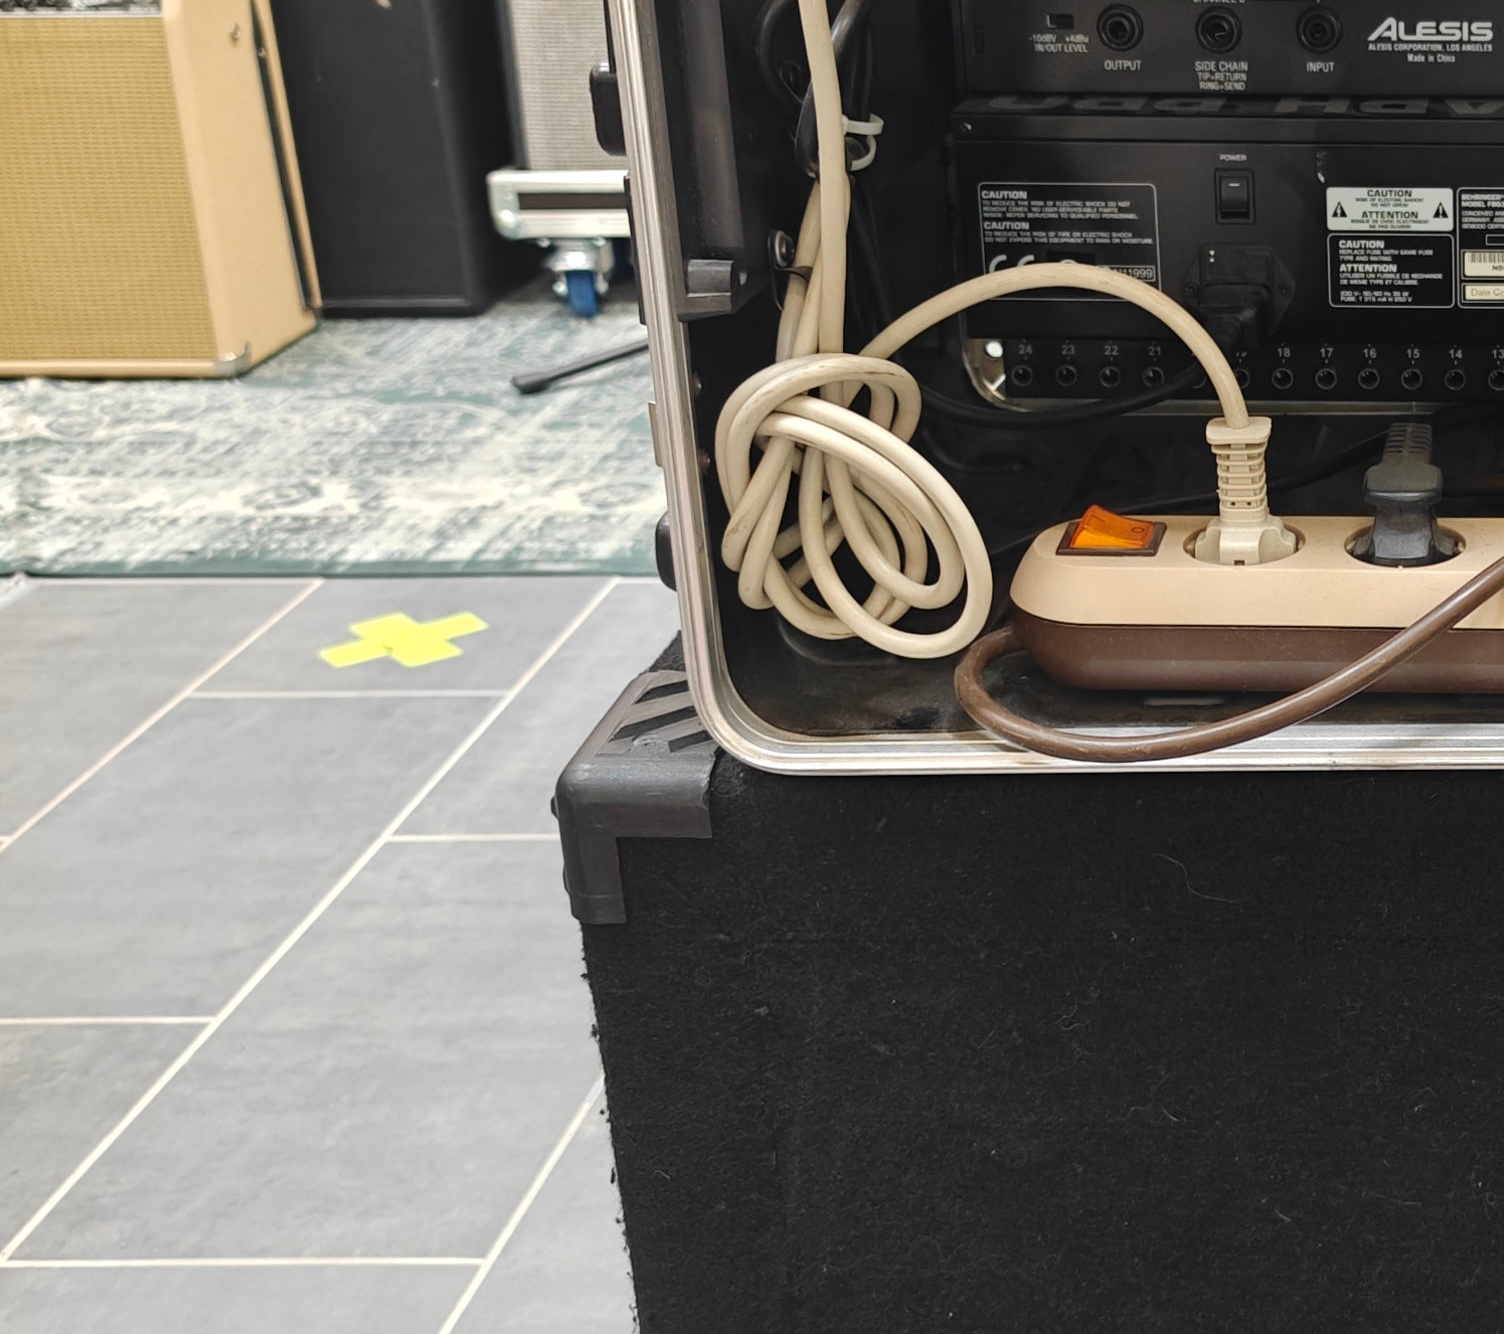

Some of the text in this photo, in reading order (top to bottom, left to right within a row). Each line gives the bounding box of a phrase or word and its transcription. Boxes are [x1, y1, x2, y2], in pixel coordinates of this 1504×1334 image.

[1367, 17, 1493, 41] ALESIS
[1035, 44, 1087, 52] IN/OUT LEVEL
[1408, 54, 1455, 62] Made in China
[1104, 61, 1141, 70] OUTPUT
[1195, 62, 1248, 71] SIDE CHAIN
[1307, 63, 1334, 72] INPUT
[982, 191, 1027, 199] CAUTION
[1362, 211, 1418, 219] ATTENTION
[1018, 346, 1032, 354] 24
[1062, 346, 1075, 354] 23
[1105, 346, 1118, 355] 22
[1149, 346, 1161, 355] 21
[1278, 348, 1290, 357] 18
[1320, 348, 1333, 357] 17
[1363, 349, 1376, 358] 16
[1407, 349, 1420, 358] 15
[1450, 349, 1462, 358] 14
[1492, 349, 1504, 359] 13
